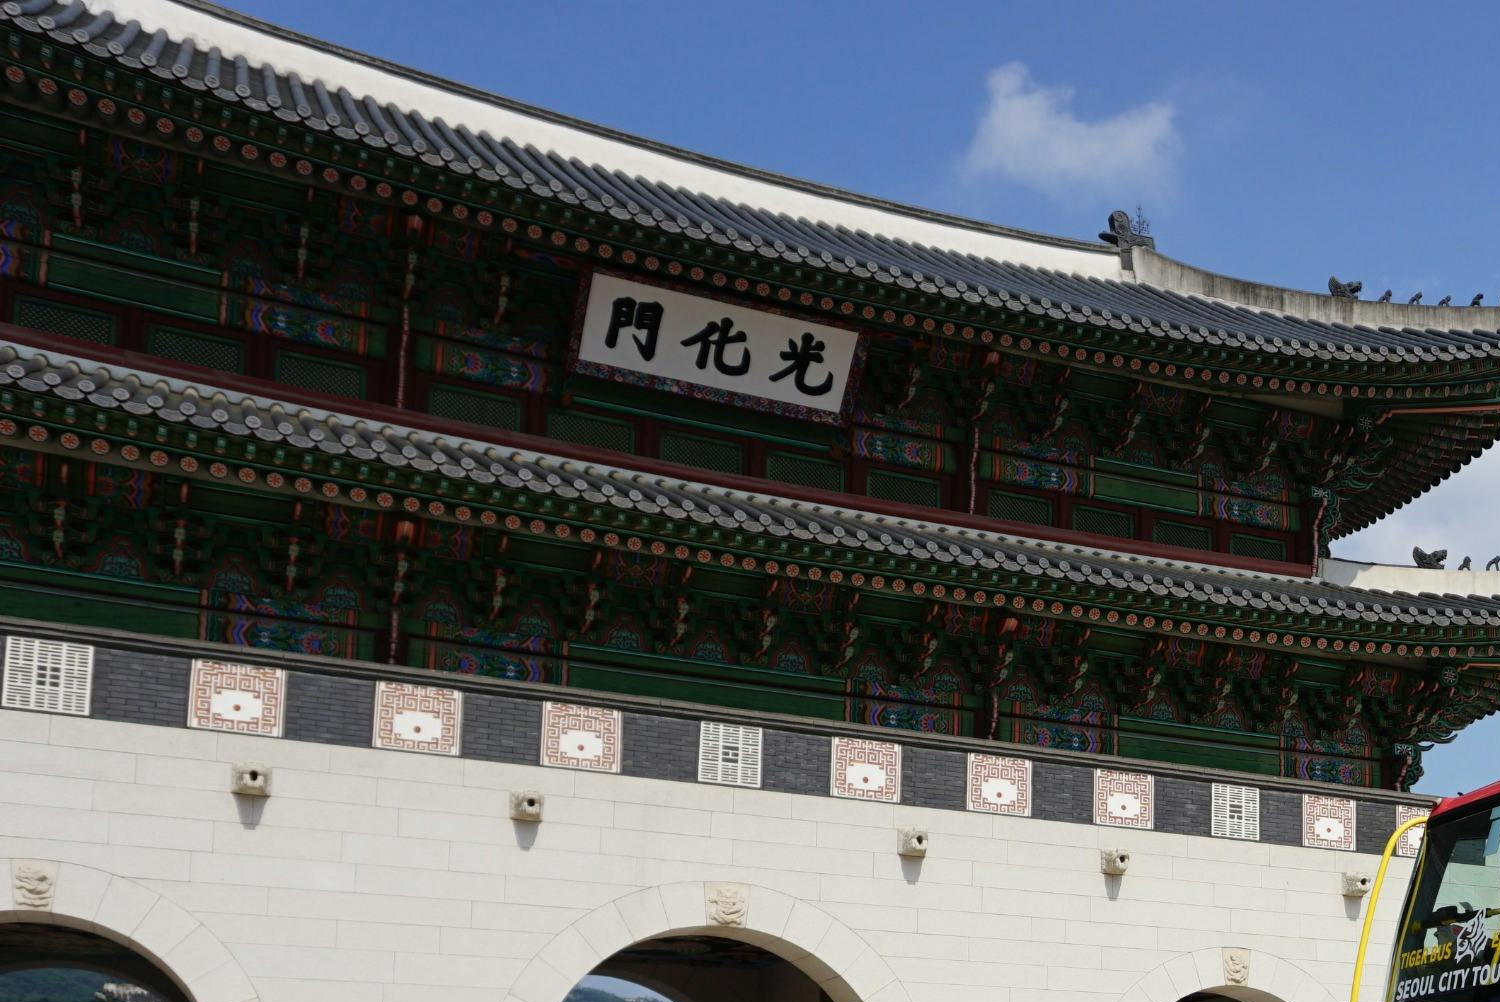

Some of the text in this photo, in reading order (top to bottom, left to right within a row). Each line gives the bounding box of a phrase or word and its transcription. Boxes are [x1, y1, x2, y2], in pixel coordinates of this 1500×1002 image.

[1401, 942, 1452, 969] TIGER BUS
[1396, 974, 1435, 1000] SEOUL
[1438, 967, 1471, 992] CITY
